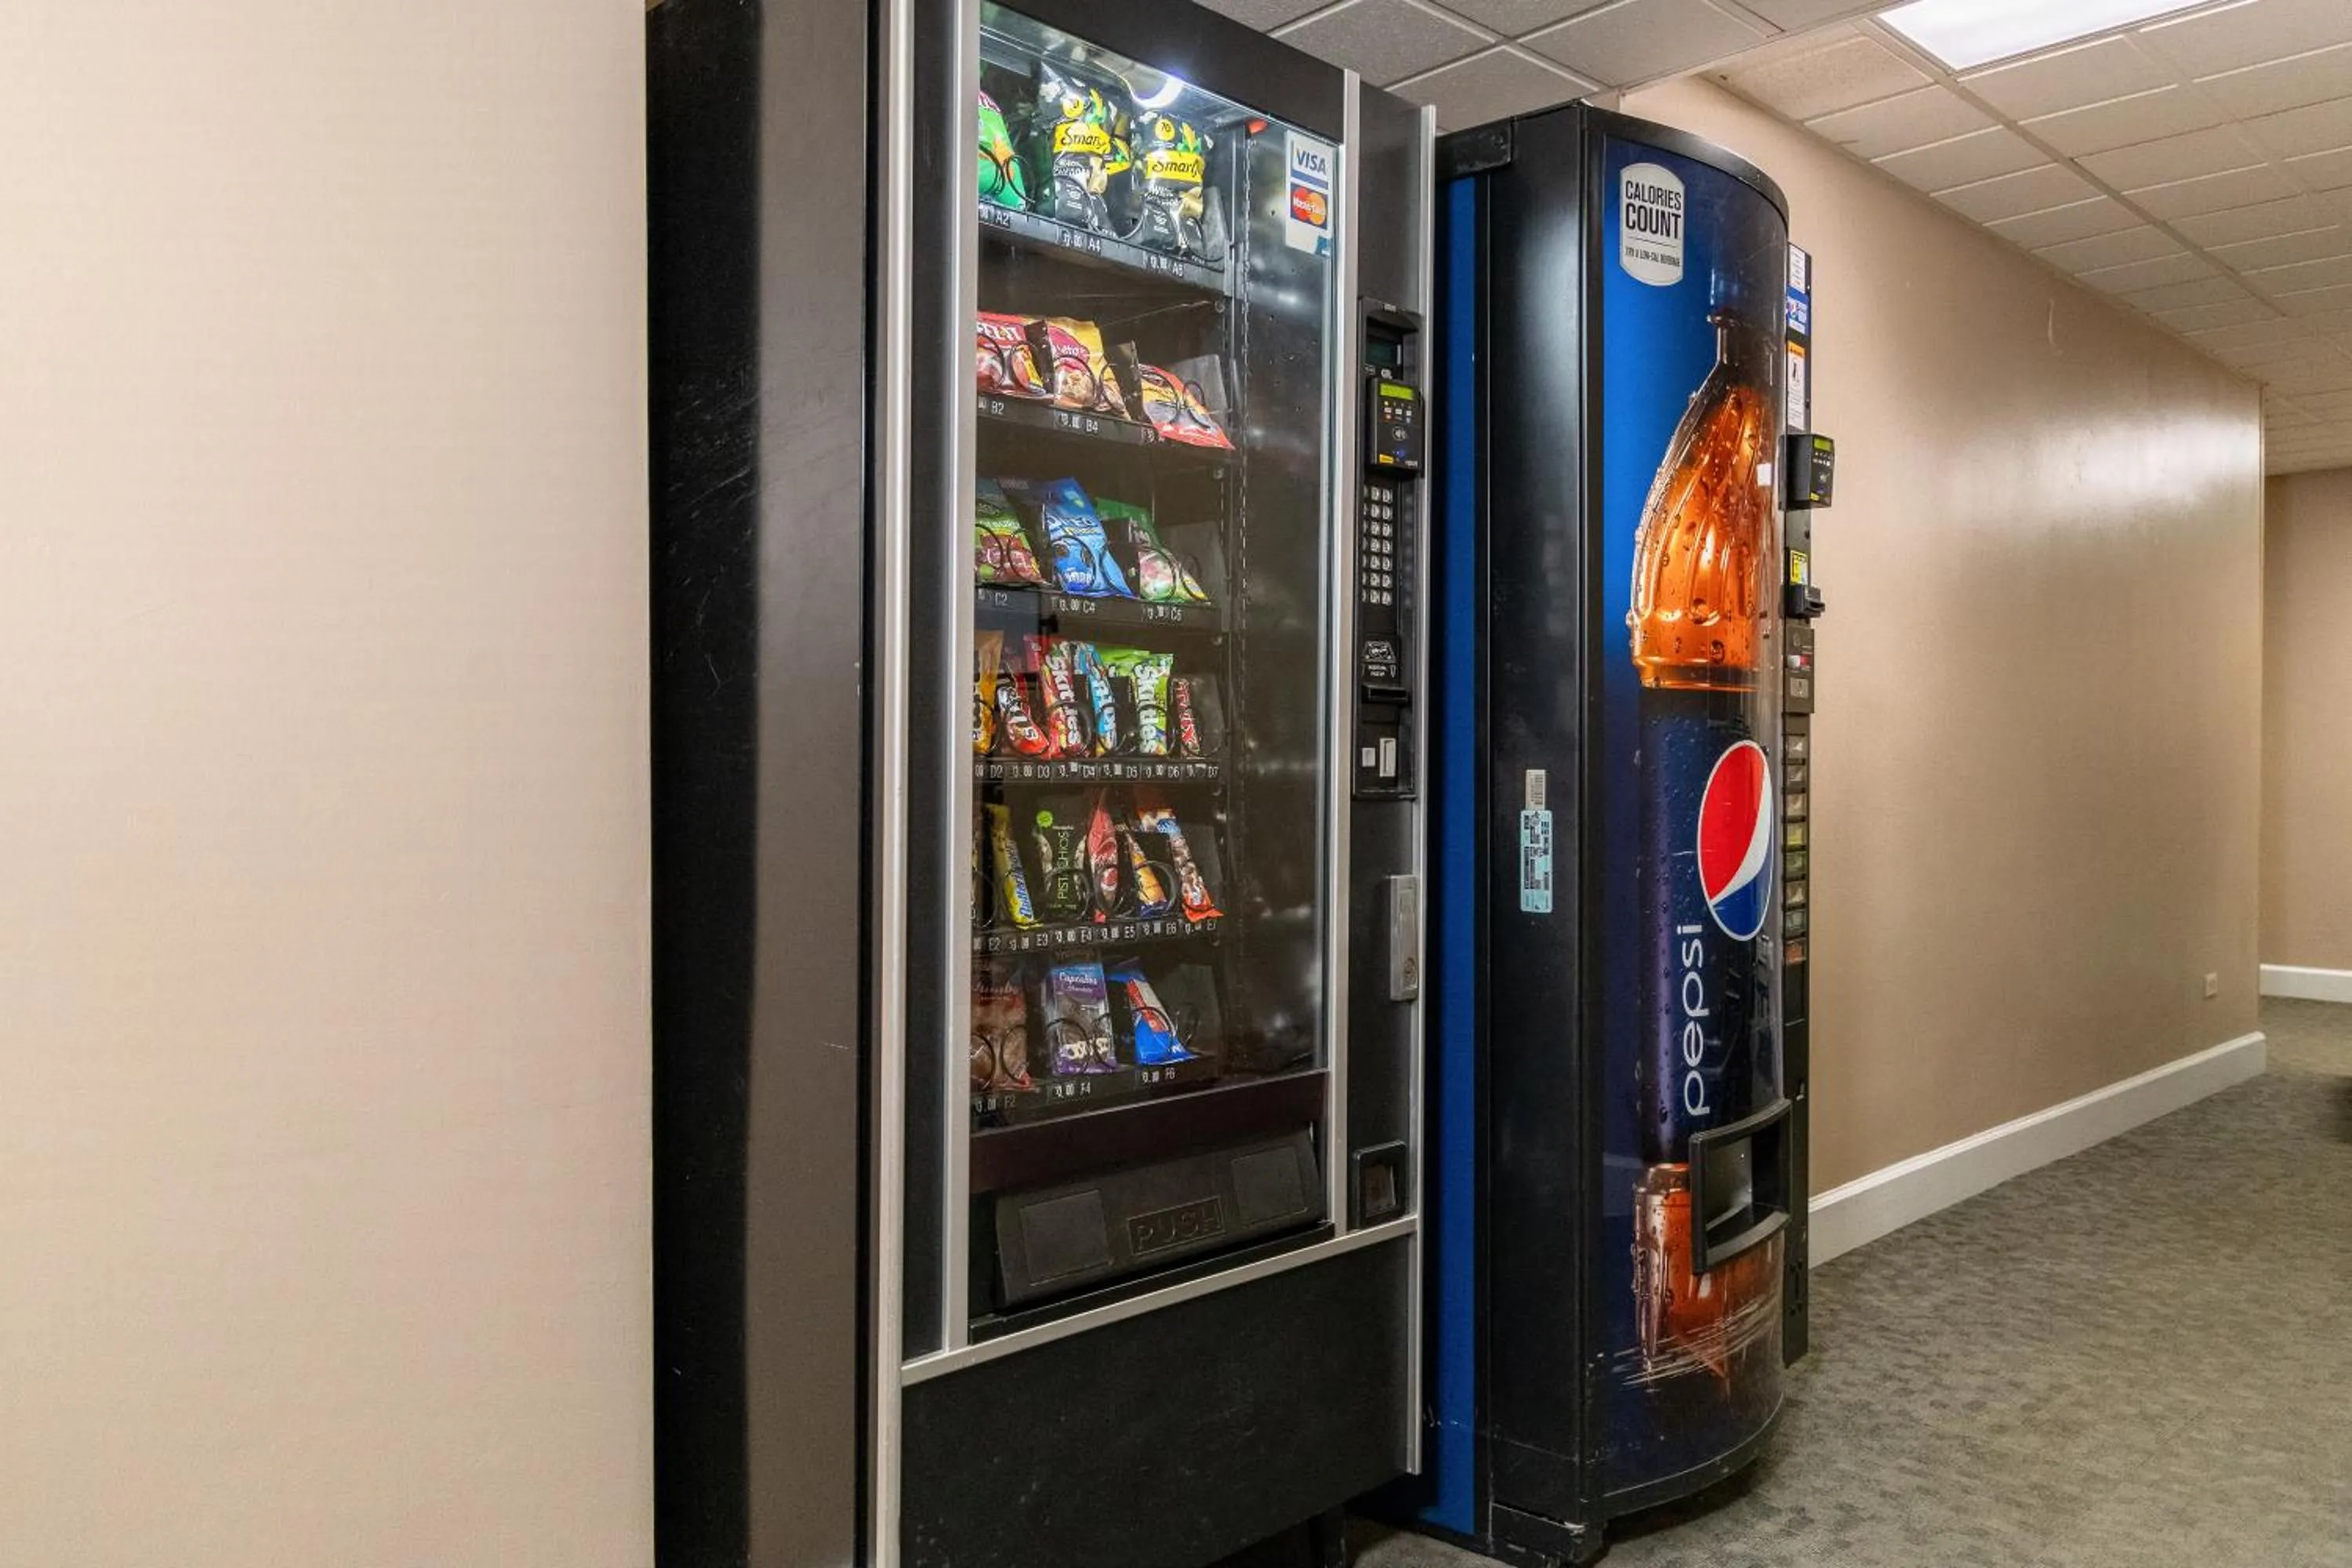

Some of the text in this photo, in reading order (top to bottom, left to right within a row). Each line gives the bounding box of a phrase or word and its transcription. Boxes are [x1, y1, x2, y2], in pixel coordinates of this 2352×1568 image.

[1296, 147, 1327, 176] VISA
[1624, 180, 1682, 211] CALORIES
[1624, 202, 1682, 239] COUNT
[989, 764, 1004, 779] D2
[1058, 830, 1069, 900] PISTCHIOS
[1677, 924, 1710, 1116] pepsi
[1137, 1203, 1221, 1251] PUSH
